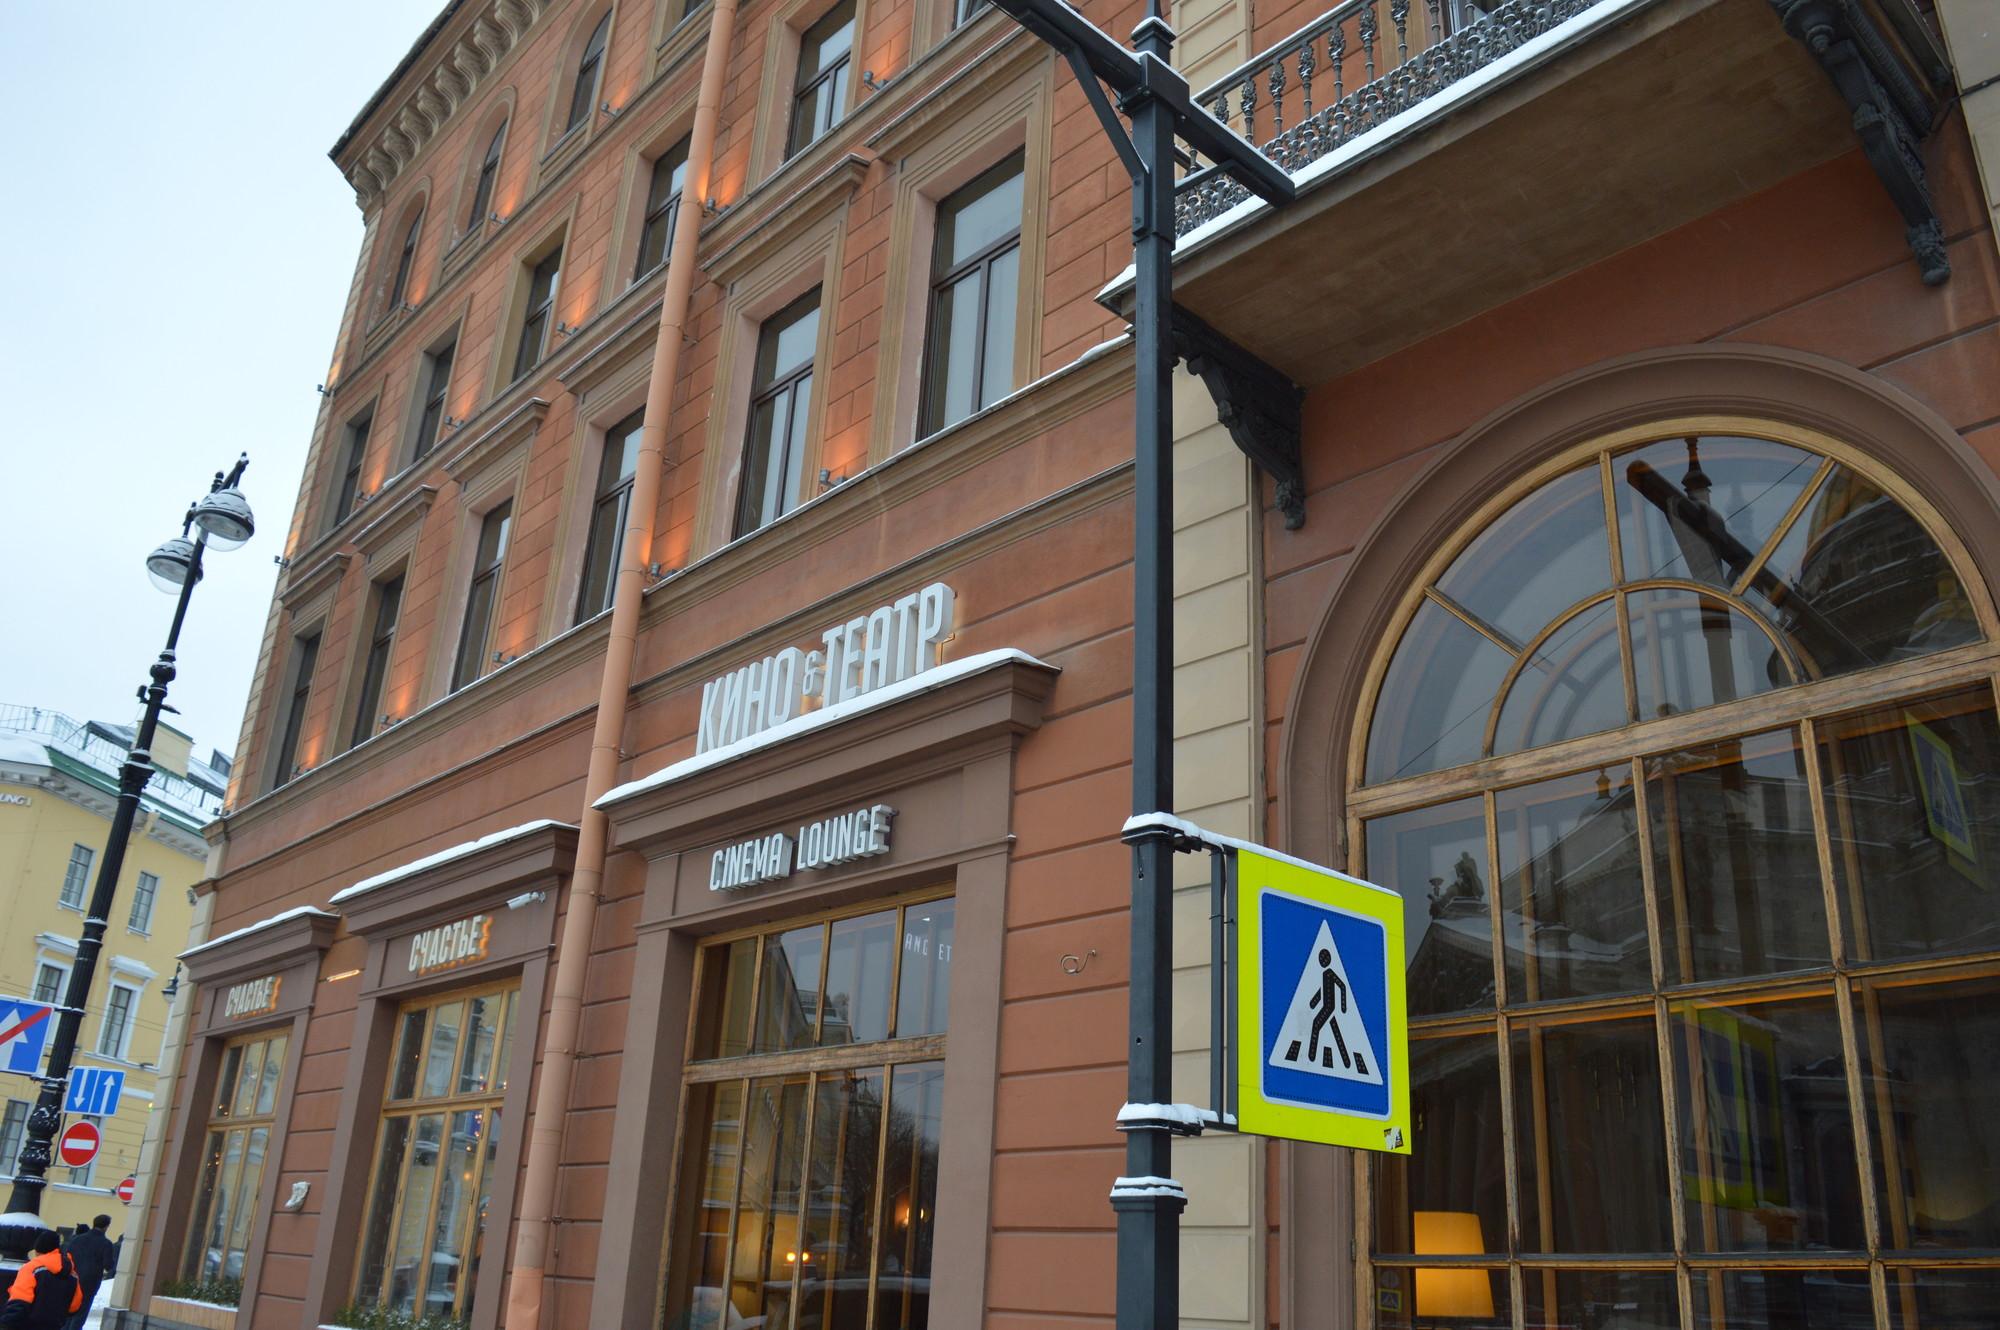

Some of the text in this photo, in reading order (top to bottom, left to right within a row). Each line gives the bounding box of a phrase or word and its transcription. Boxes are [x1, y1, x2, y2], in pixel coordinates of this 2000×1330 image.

[709, 803, 896, 891] CINEMA LOUNGE
[408, 914, 487, 972] СЧАСТЬЕ
[224, 976, 277, 1017] СЧАСТЬЕ
